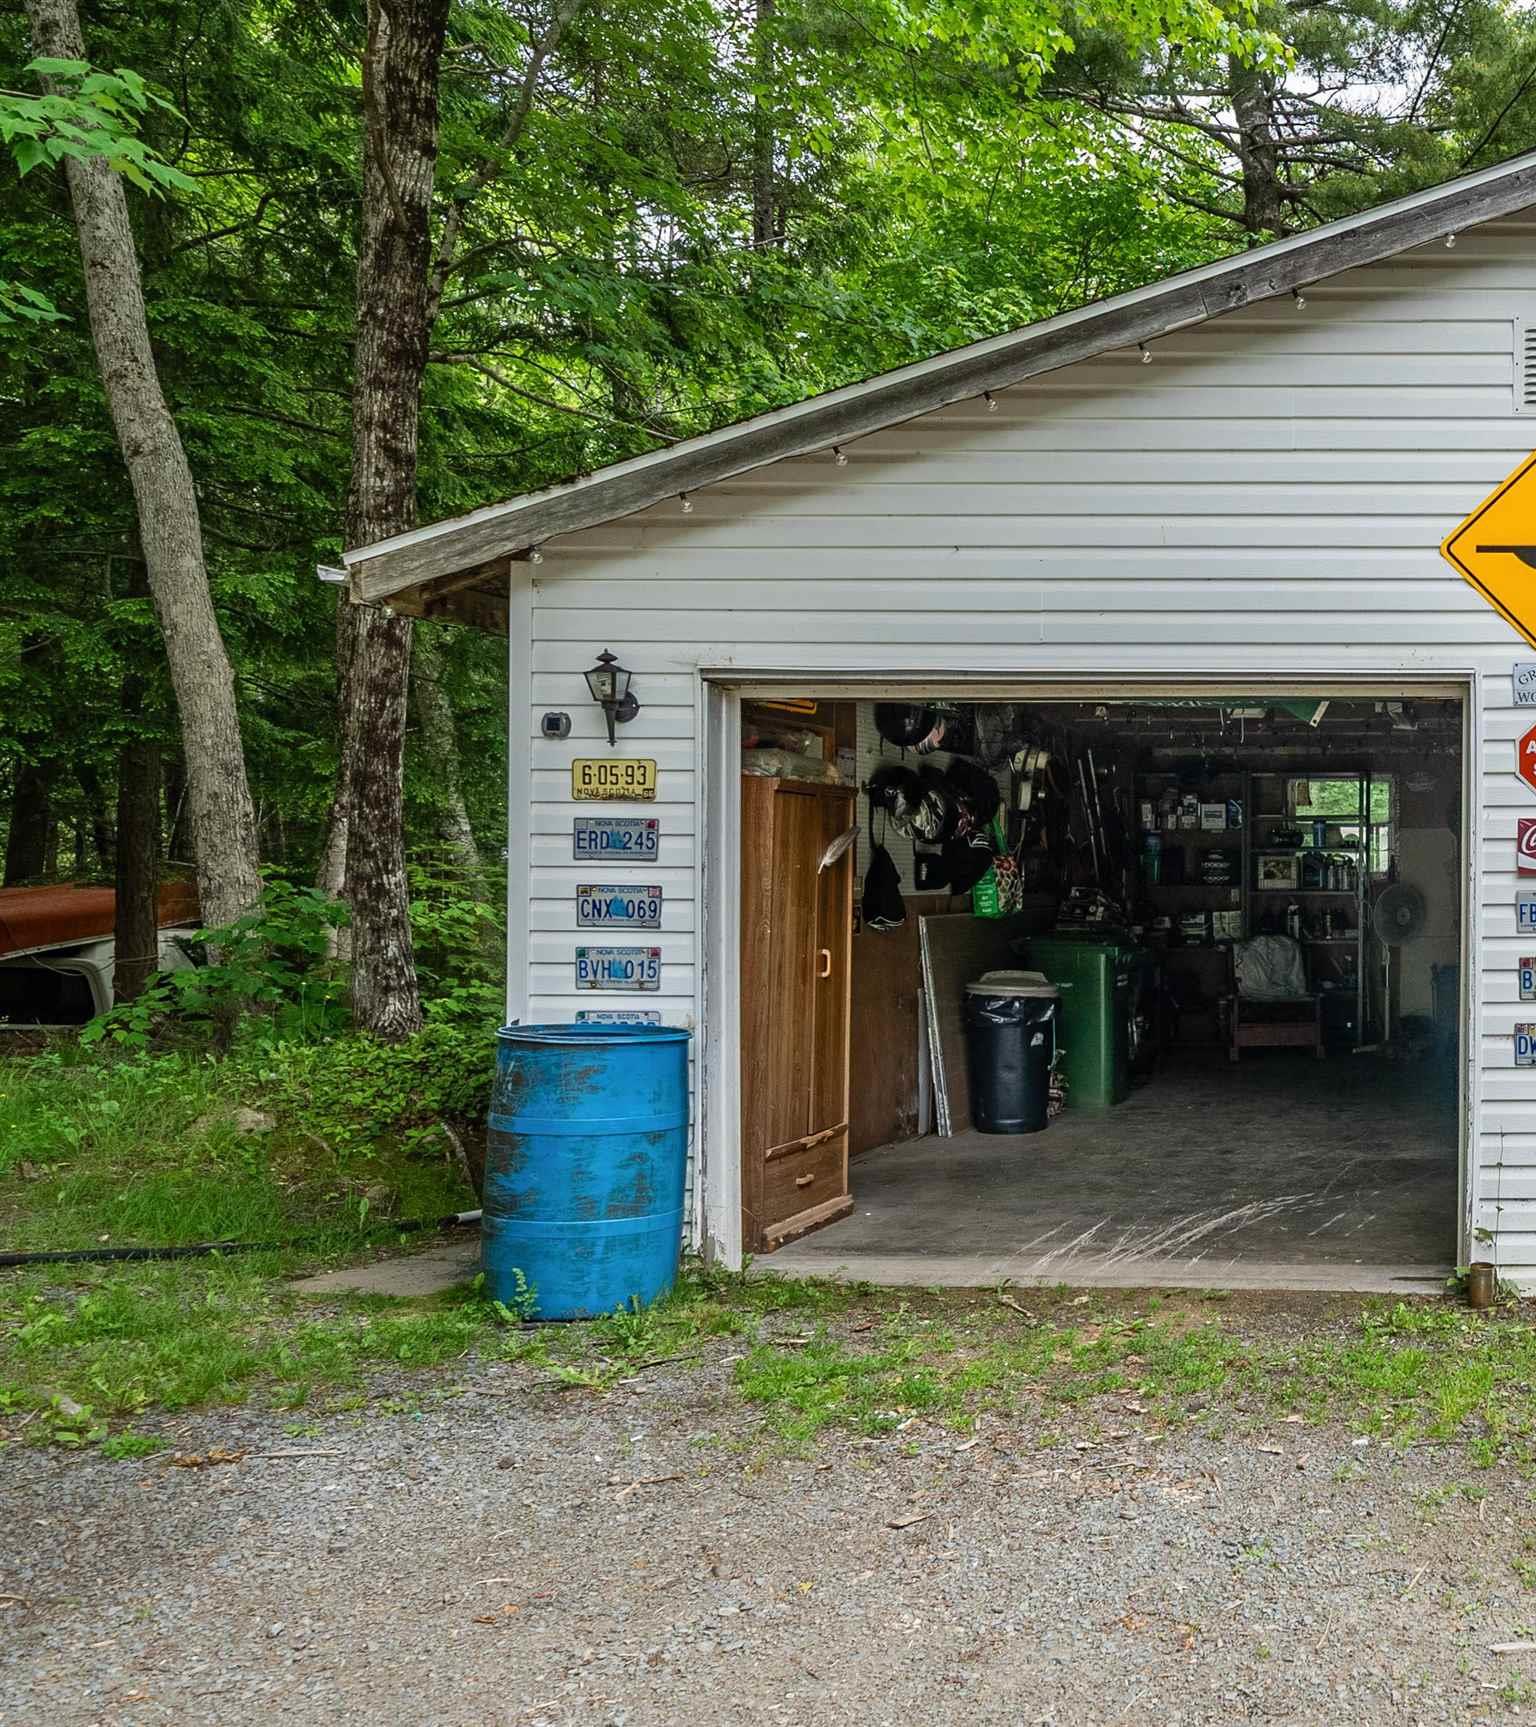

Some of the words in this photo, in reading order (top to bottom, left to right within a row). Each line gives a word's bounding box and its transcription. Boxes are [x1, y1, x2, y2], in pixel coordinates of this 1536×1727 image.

[576, 831, 610, 850] ERD
[623, 831, 656, 850] 245
[581, 899, 613, 918] CNX
[625, 899, 658, 919] 069
[578, 960, 611, 979] BVH
[624, 960, 657, 979] 015
